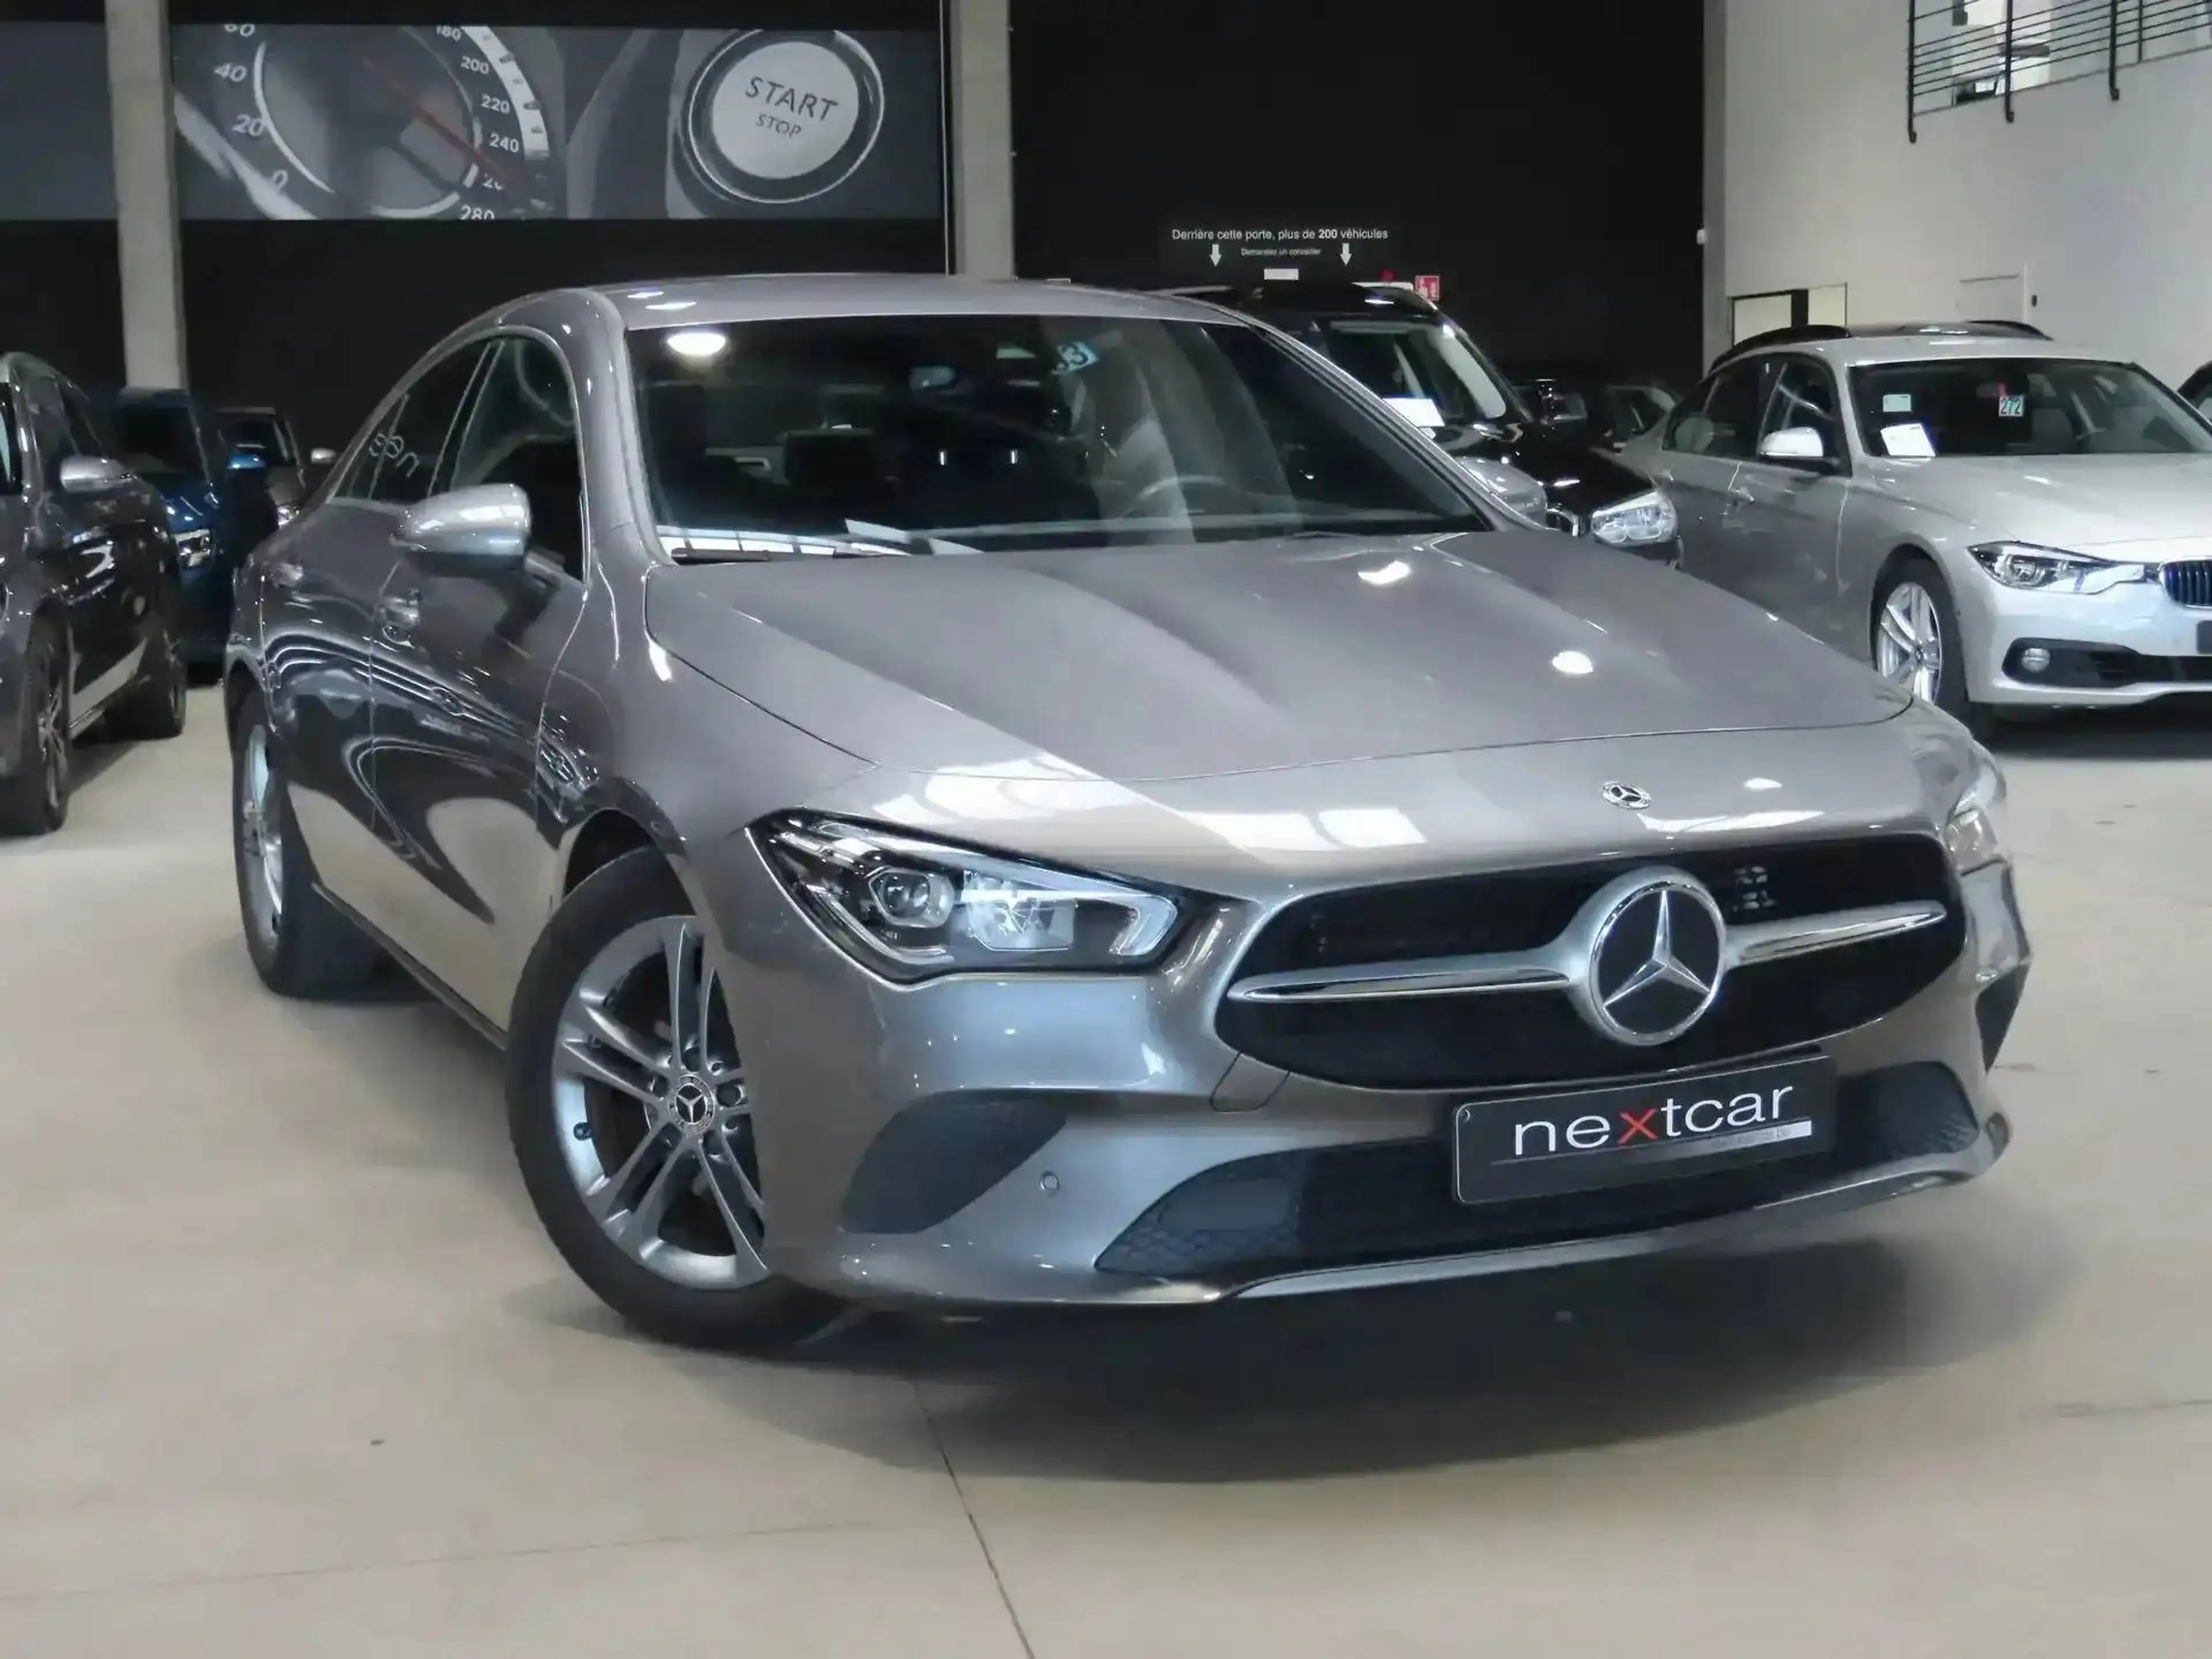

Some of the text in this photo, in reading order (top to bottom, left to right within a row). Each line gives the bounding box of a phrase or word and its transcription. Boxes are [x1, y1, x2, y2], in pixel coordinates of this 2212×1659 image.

[214, 63, 248, 82] 40
[461, 56, 489, 74] 200
[480, 94, 510, 114] 220
[745, 76, 839, 120] START
[231, 114, 265, 137] 20
[756, 113, 802, 138] STOP
[489, 133, 519, 153] 240
[1172, 229, 1389, 242] Derrière cette porte, plus de 200 véhicules
[1515, 1086, 1794, 1156] nextcar
